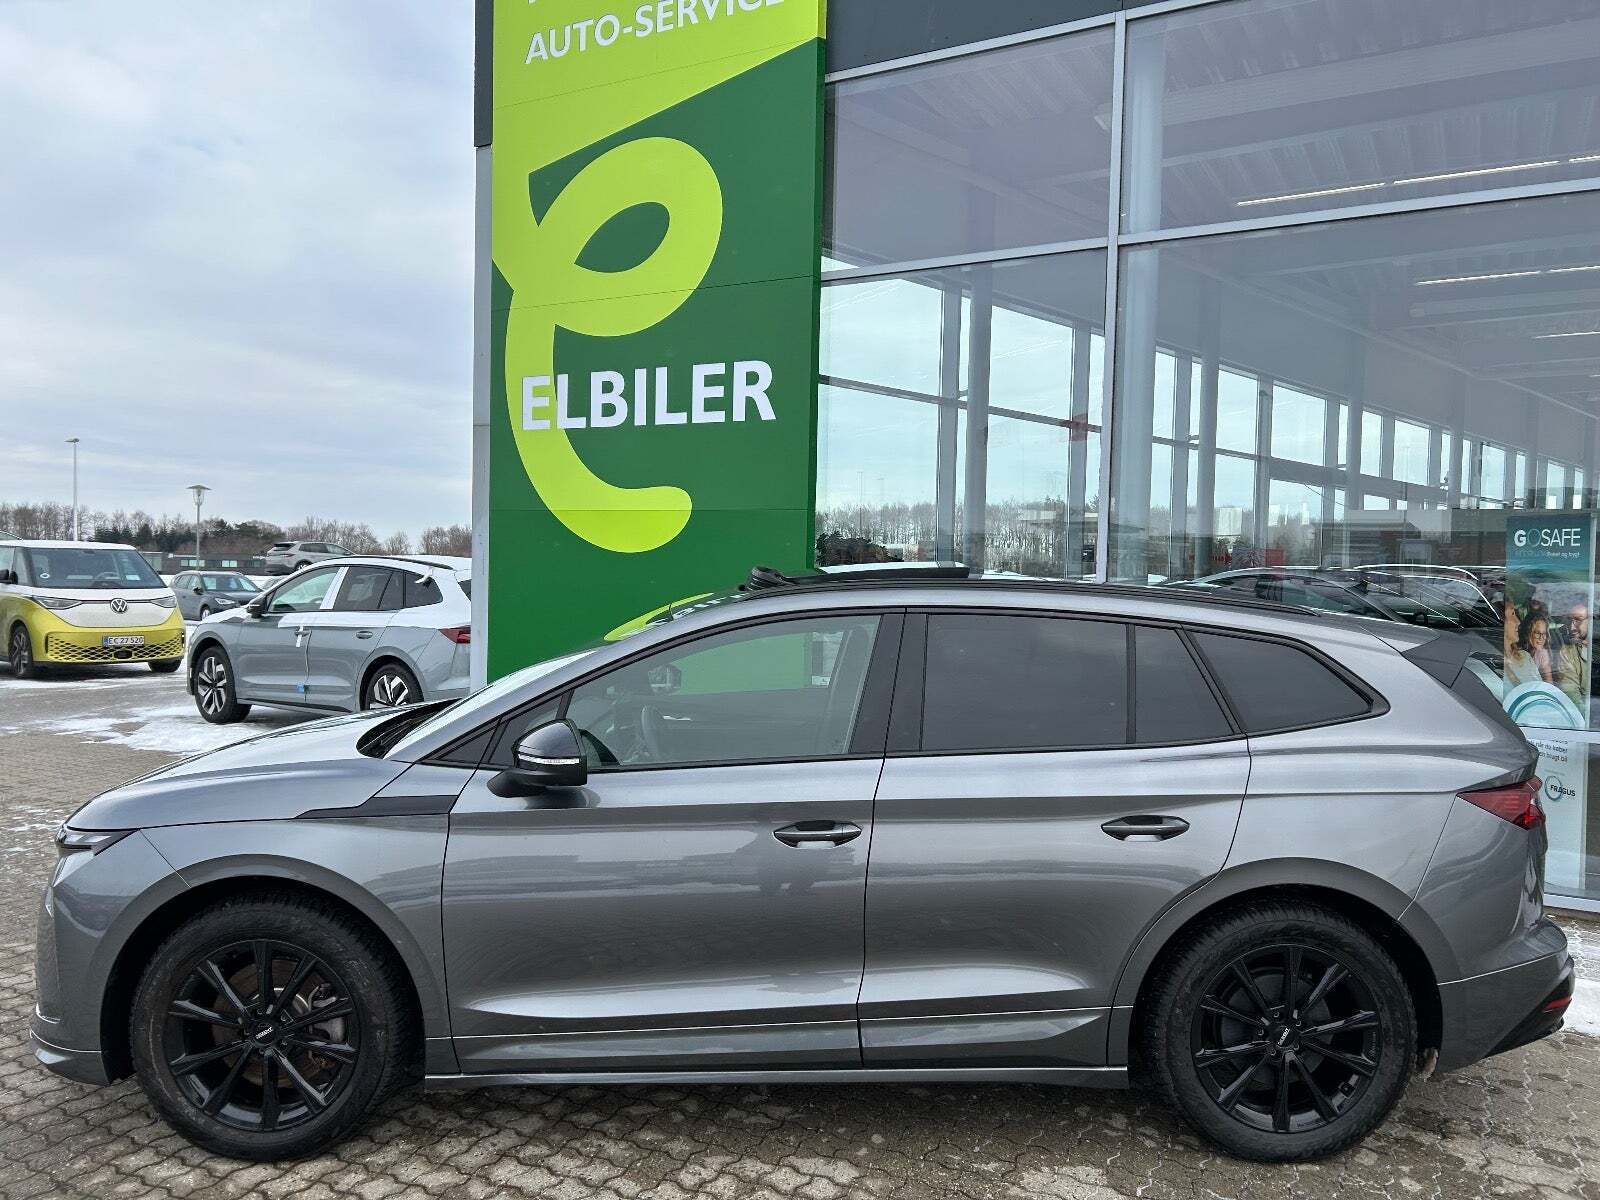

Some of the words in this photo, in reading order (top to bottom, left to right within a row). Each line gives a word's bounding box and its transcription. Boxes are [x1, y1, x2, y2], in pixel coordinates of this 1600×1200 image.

[525, 0, 786, 65] AUTO-SERV
[522, 360, 777, 430] ELBILER
[1514, 528, 1581, 547] GOSAFE
[1550, 784, 1576, 797] FRAGUS
